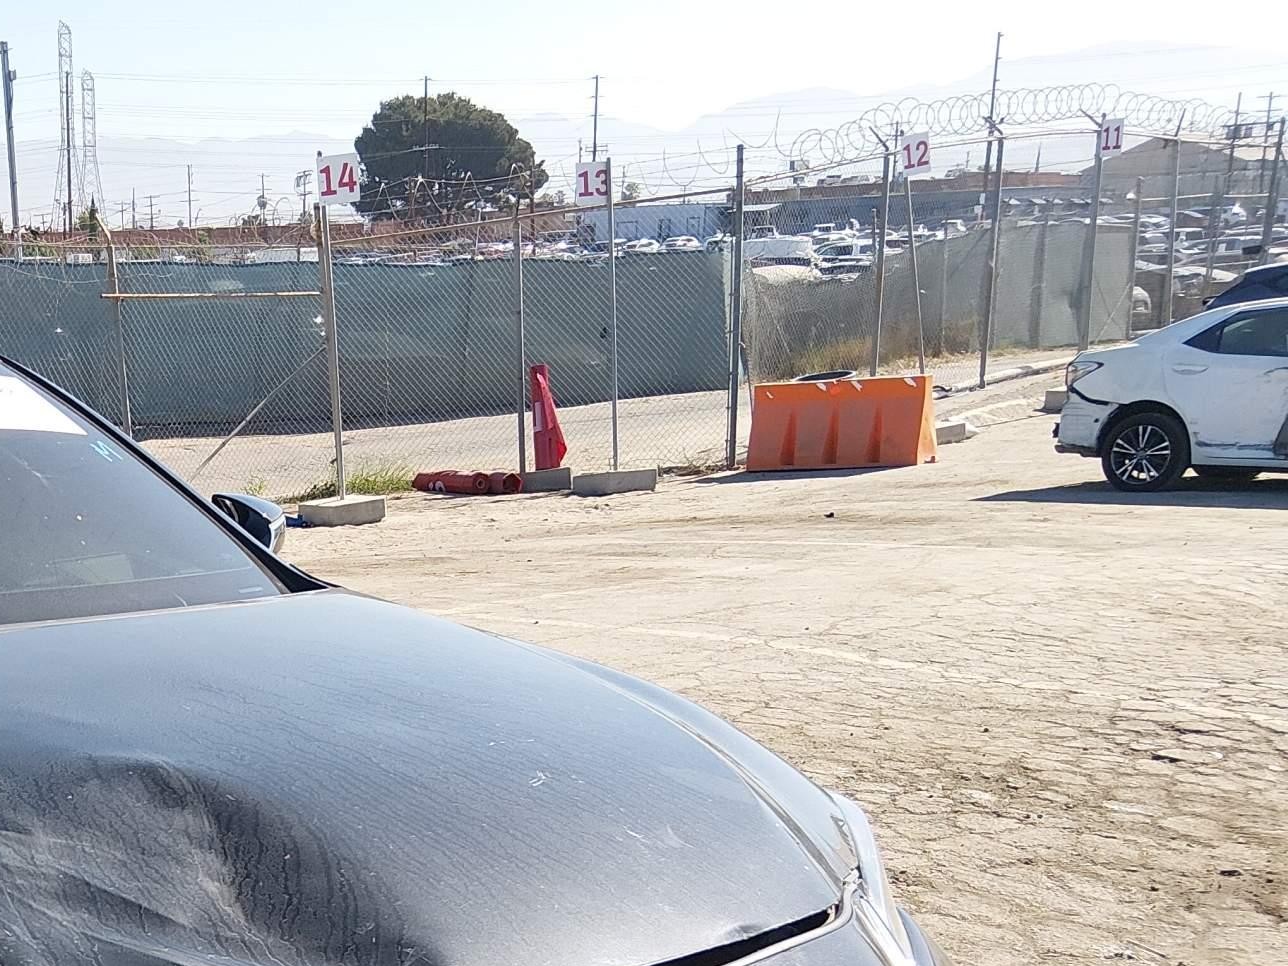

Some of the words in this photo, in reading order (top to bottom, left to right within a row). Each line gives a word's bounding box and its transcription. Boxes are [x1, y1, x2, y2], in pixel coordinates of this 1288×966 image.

[1102, 125, 1121, 150] 11
[903, 140, 929, 169] 12
[319, 162, 357, 197] 14
[578, 169, 608, 197] 13
